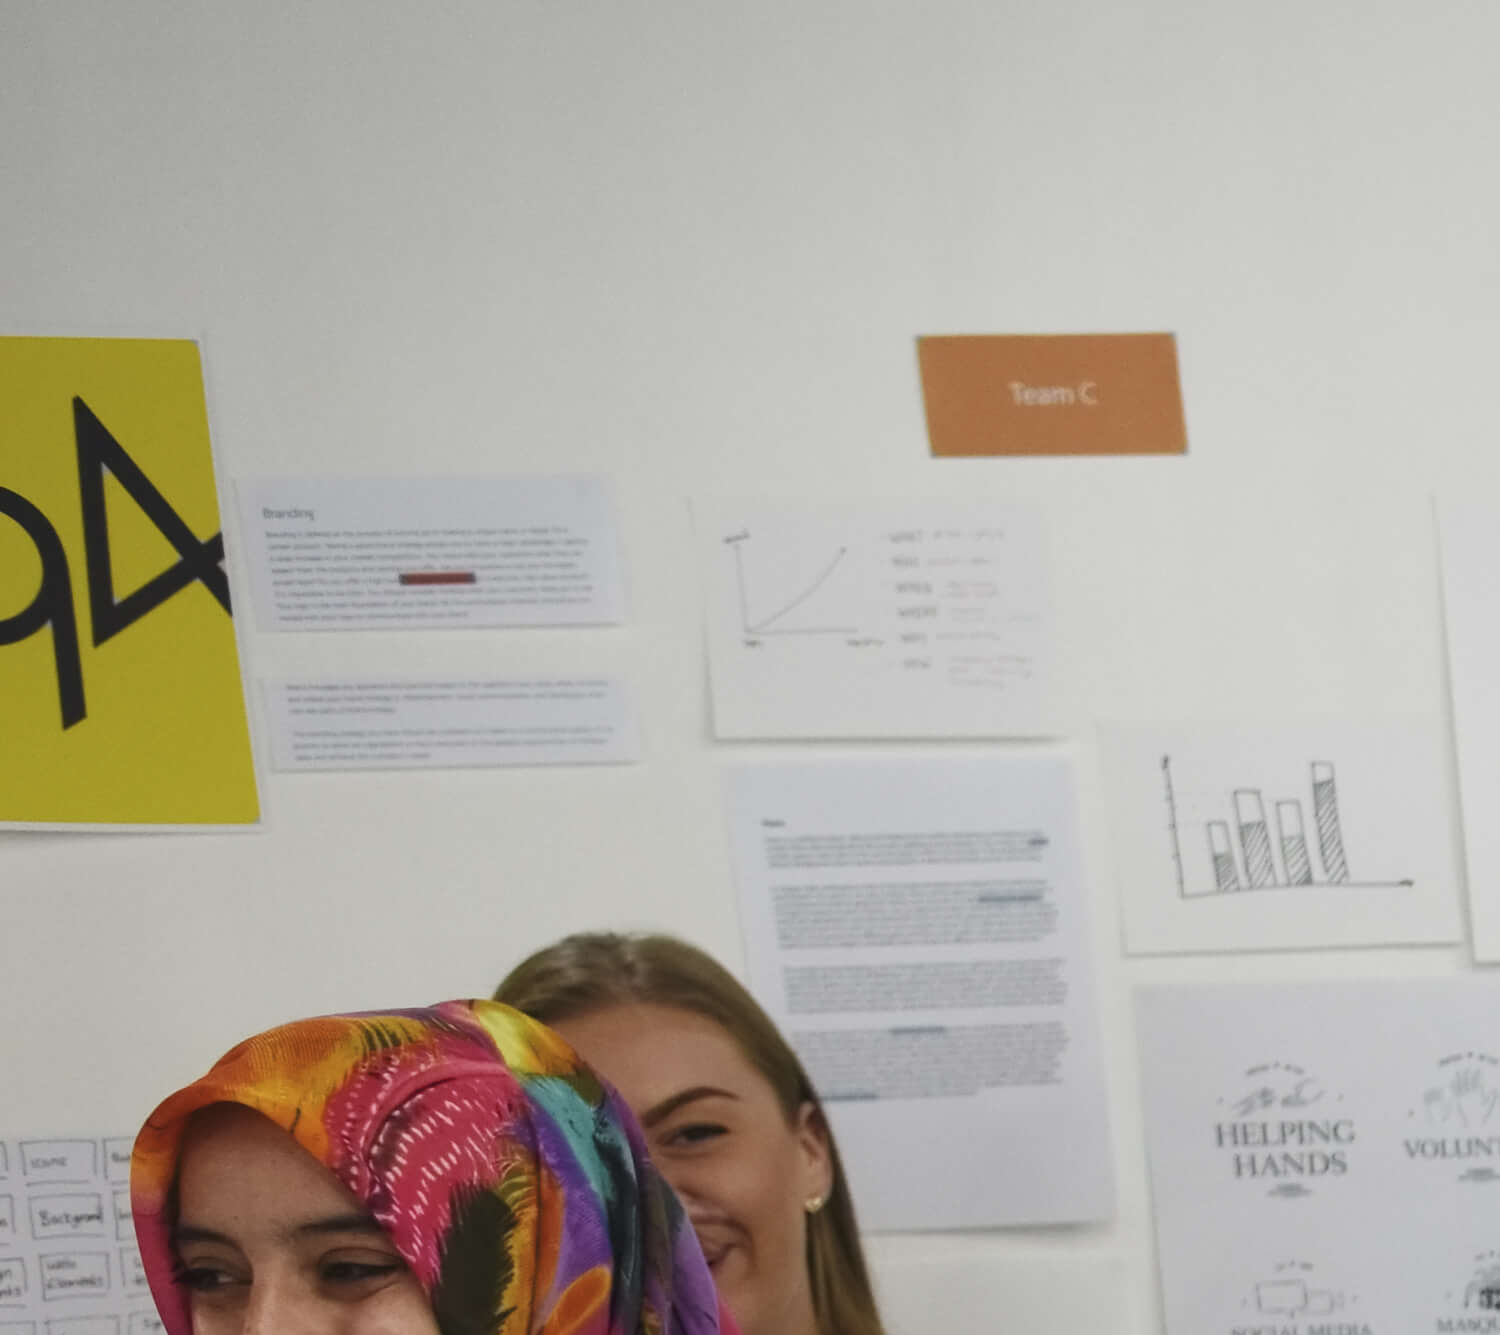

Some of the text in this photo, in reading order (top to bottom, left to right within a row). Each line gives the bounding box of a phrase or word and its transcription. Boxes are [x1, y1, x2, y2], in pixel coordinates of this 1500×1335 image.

[1008, 380, 1097, 406] Team C
[1213, 1119, 1356, 1147] HELPING
[1233, 1151, 1348, 1178] HANDS
